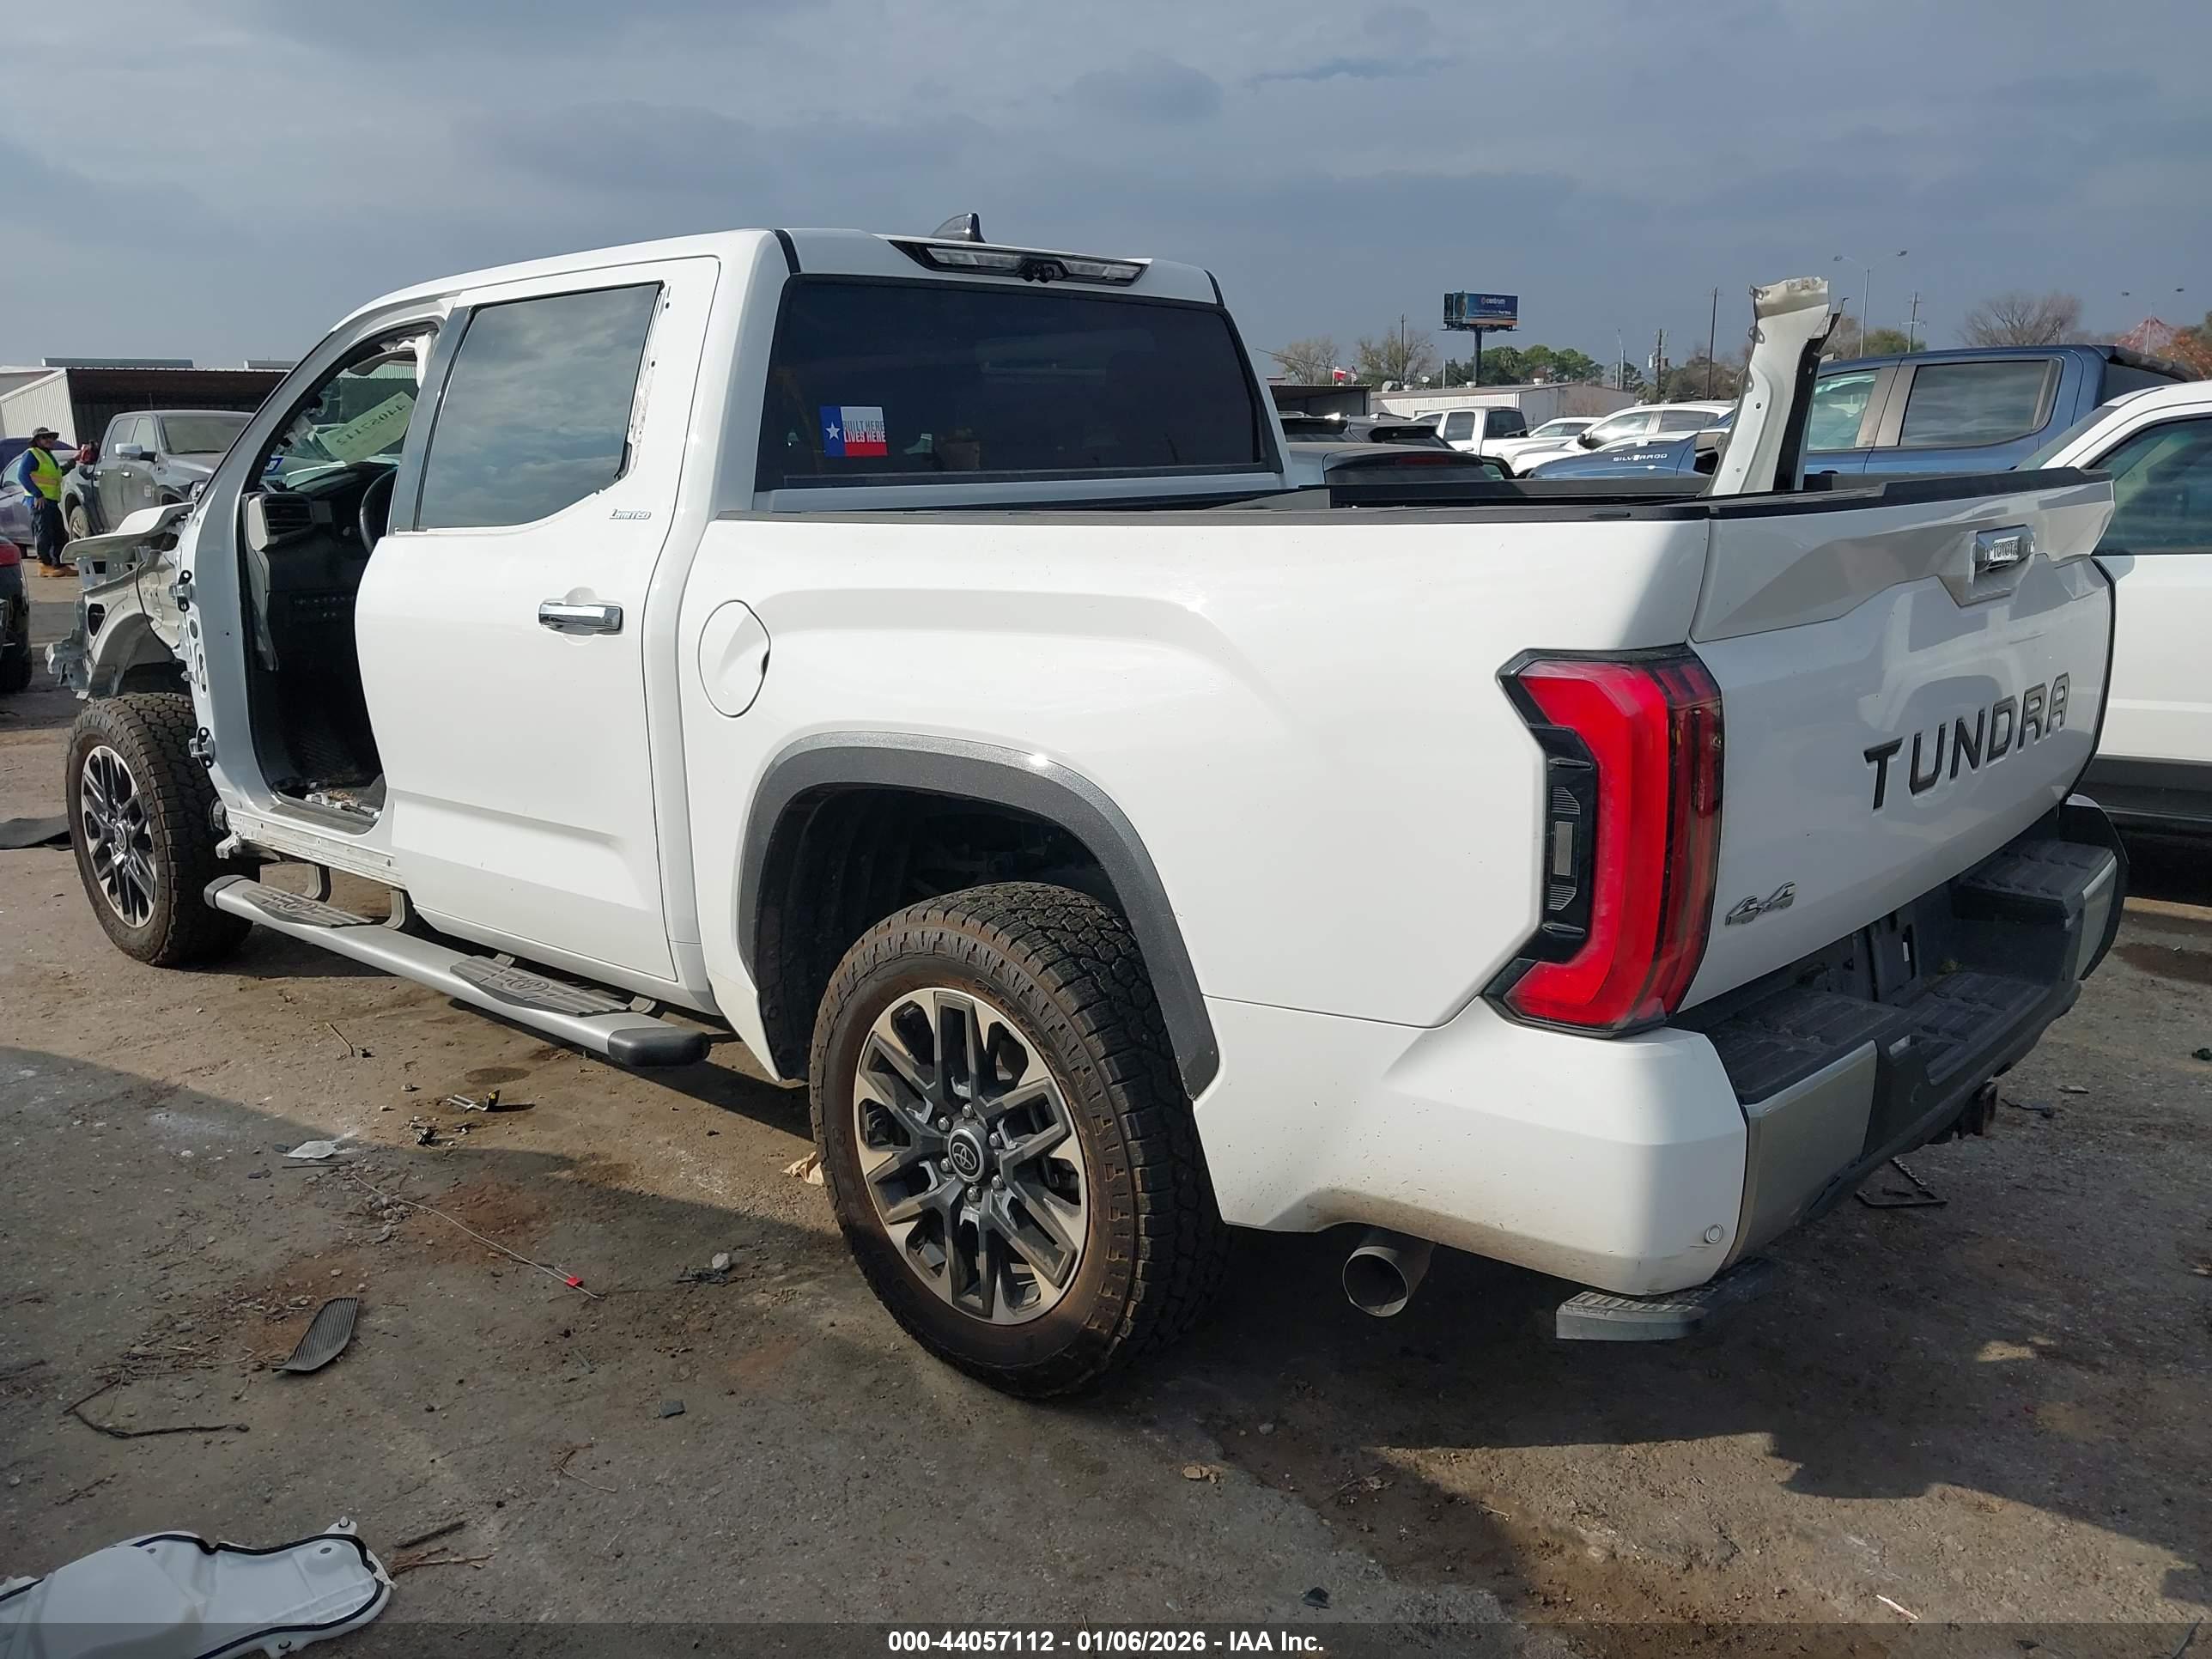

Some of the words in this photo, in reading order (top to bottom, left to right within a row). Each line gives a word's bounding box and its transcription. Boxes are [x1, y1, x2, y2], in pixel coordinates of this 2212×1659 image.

[843, 420, 865, 432] BUILT
[866, 420, 885, 432] HERE
[843, 431, 866, 443] LIVES
[866, 431, 886, 443] HERE
[1612, 453, 1668, 462] SILVERADO
[1992, 539, 2020, 558] TOYOTA
[1863, 672, 2070, 811] TUNDRA
